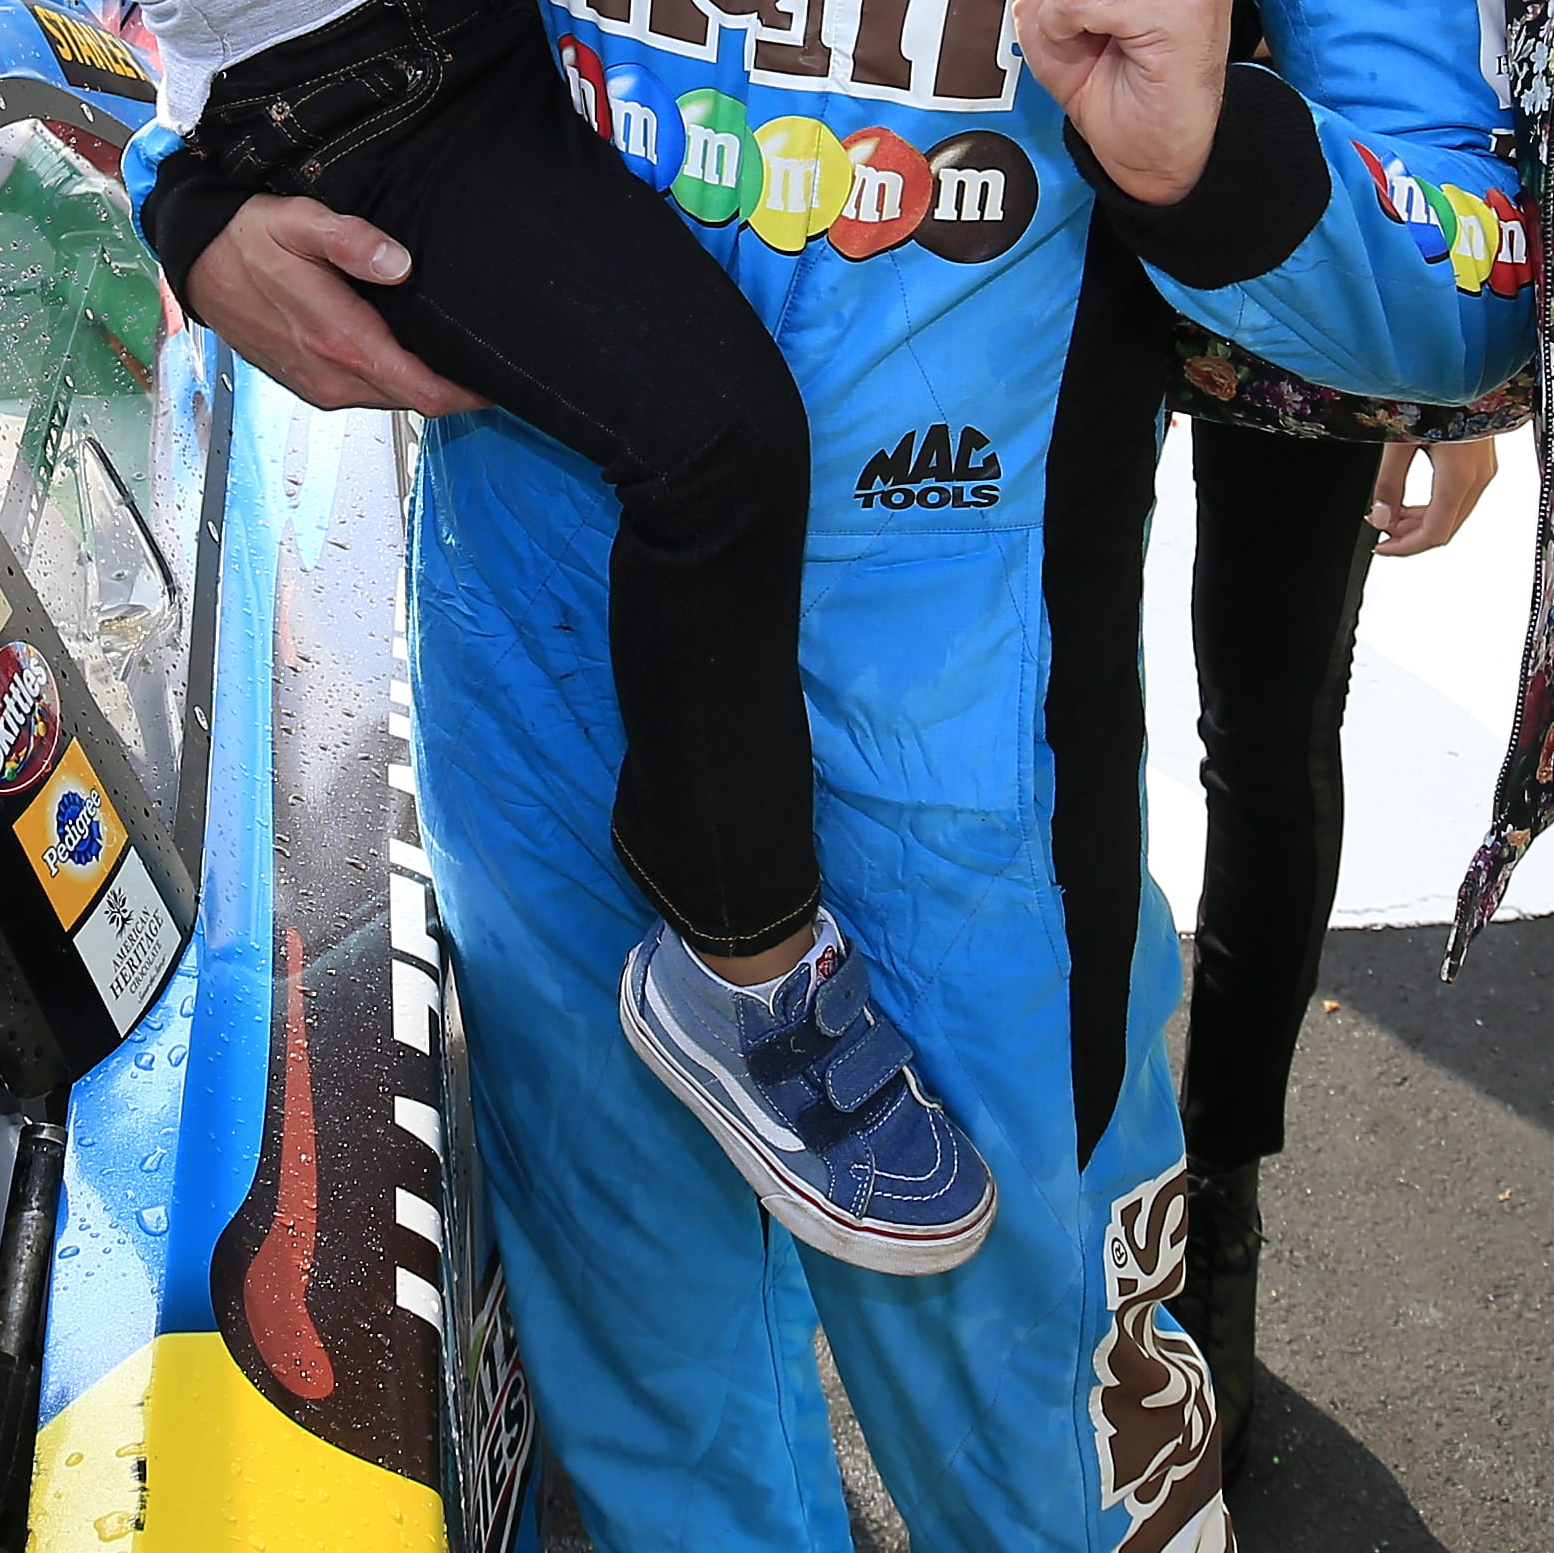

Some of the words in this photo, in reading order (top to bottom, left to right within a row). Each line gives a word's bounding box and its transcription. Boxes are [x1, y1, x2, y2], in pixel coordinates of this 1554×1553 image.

[855, 424, 1002, 490] MAC
[852, 482, 1001, 510] TOOLS
[43, 788, 102, 877] Pedigree
[109, 908, 164, 1000] HERITAGE
[111, 905, 151, 974] AMERICAN
